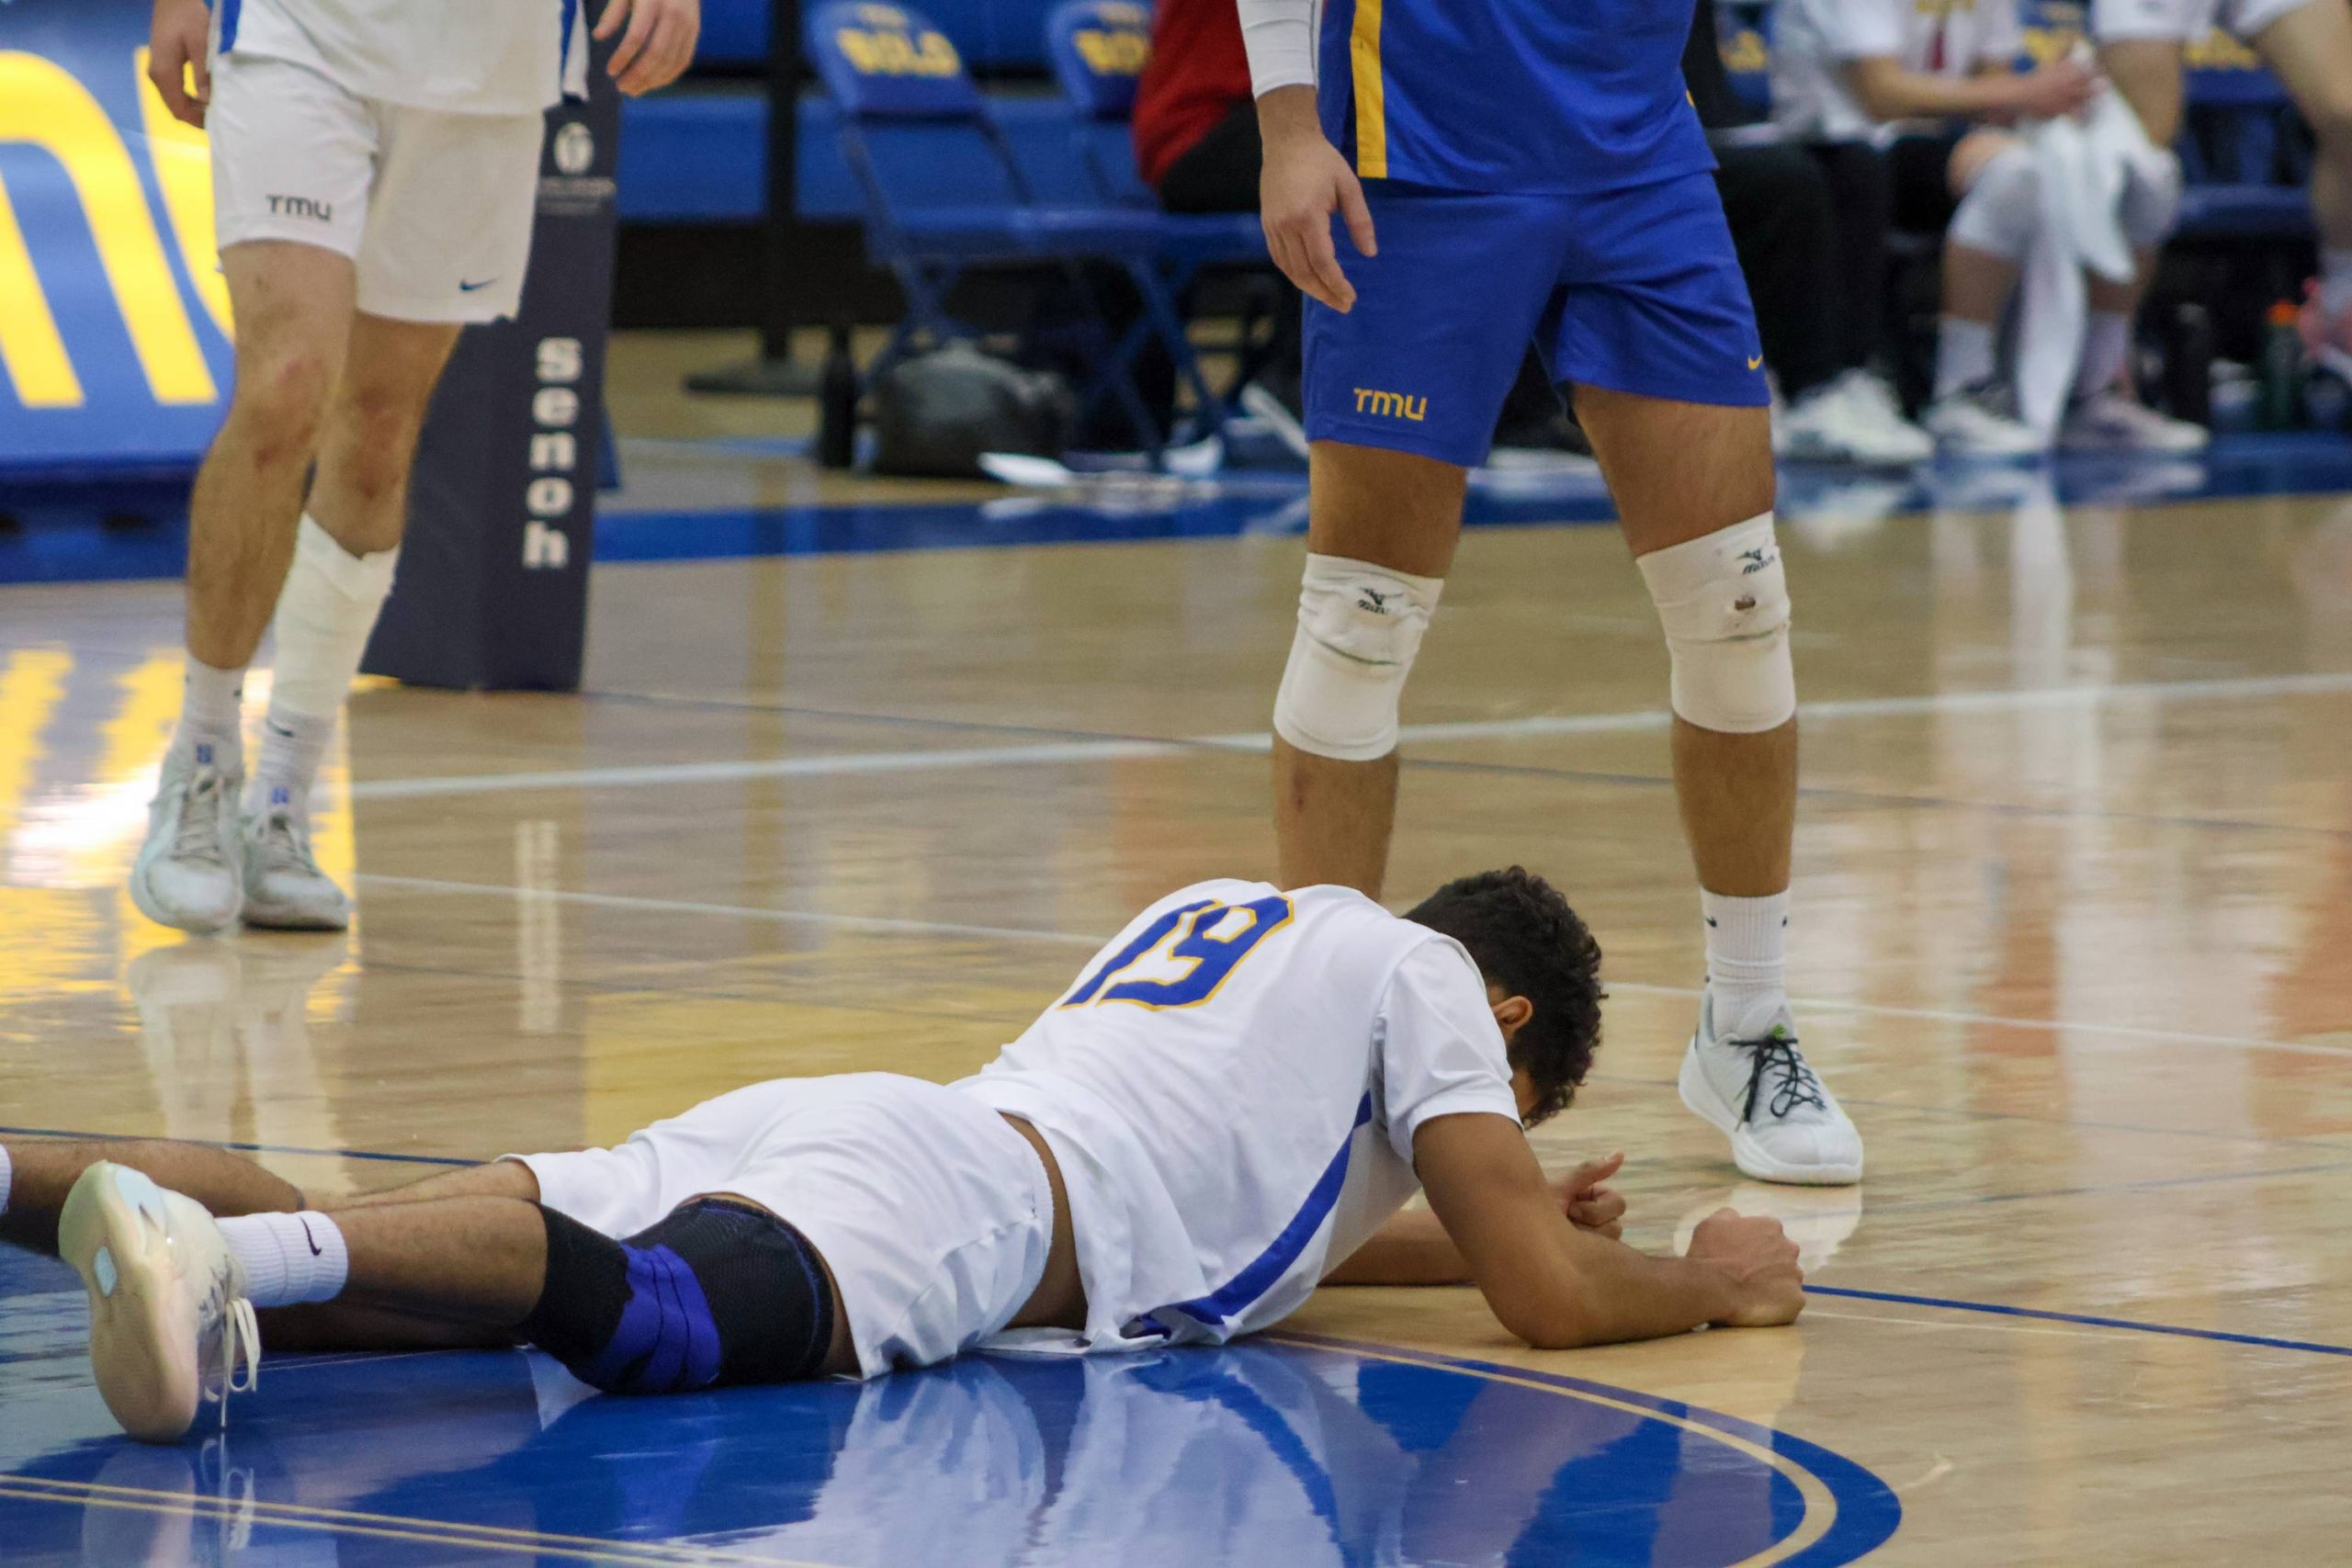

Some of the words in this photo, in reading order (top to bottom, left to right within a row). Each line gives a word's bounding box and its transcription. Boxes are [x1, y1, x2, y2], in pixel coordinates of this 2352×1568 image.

[265, 194, 333, 222] TMU
[1353, 388, 1427, 421] TMU
[1054, 895, 1295, 1011] 19
